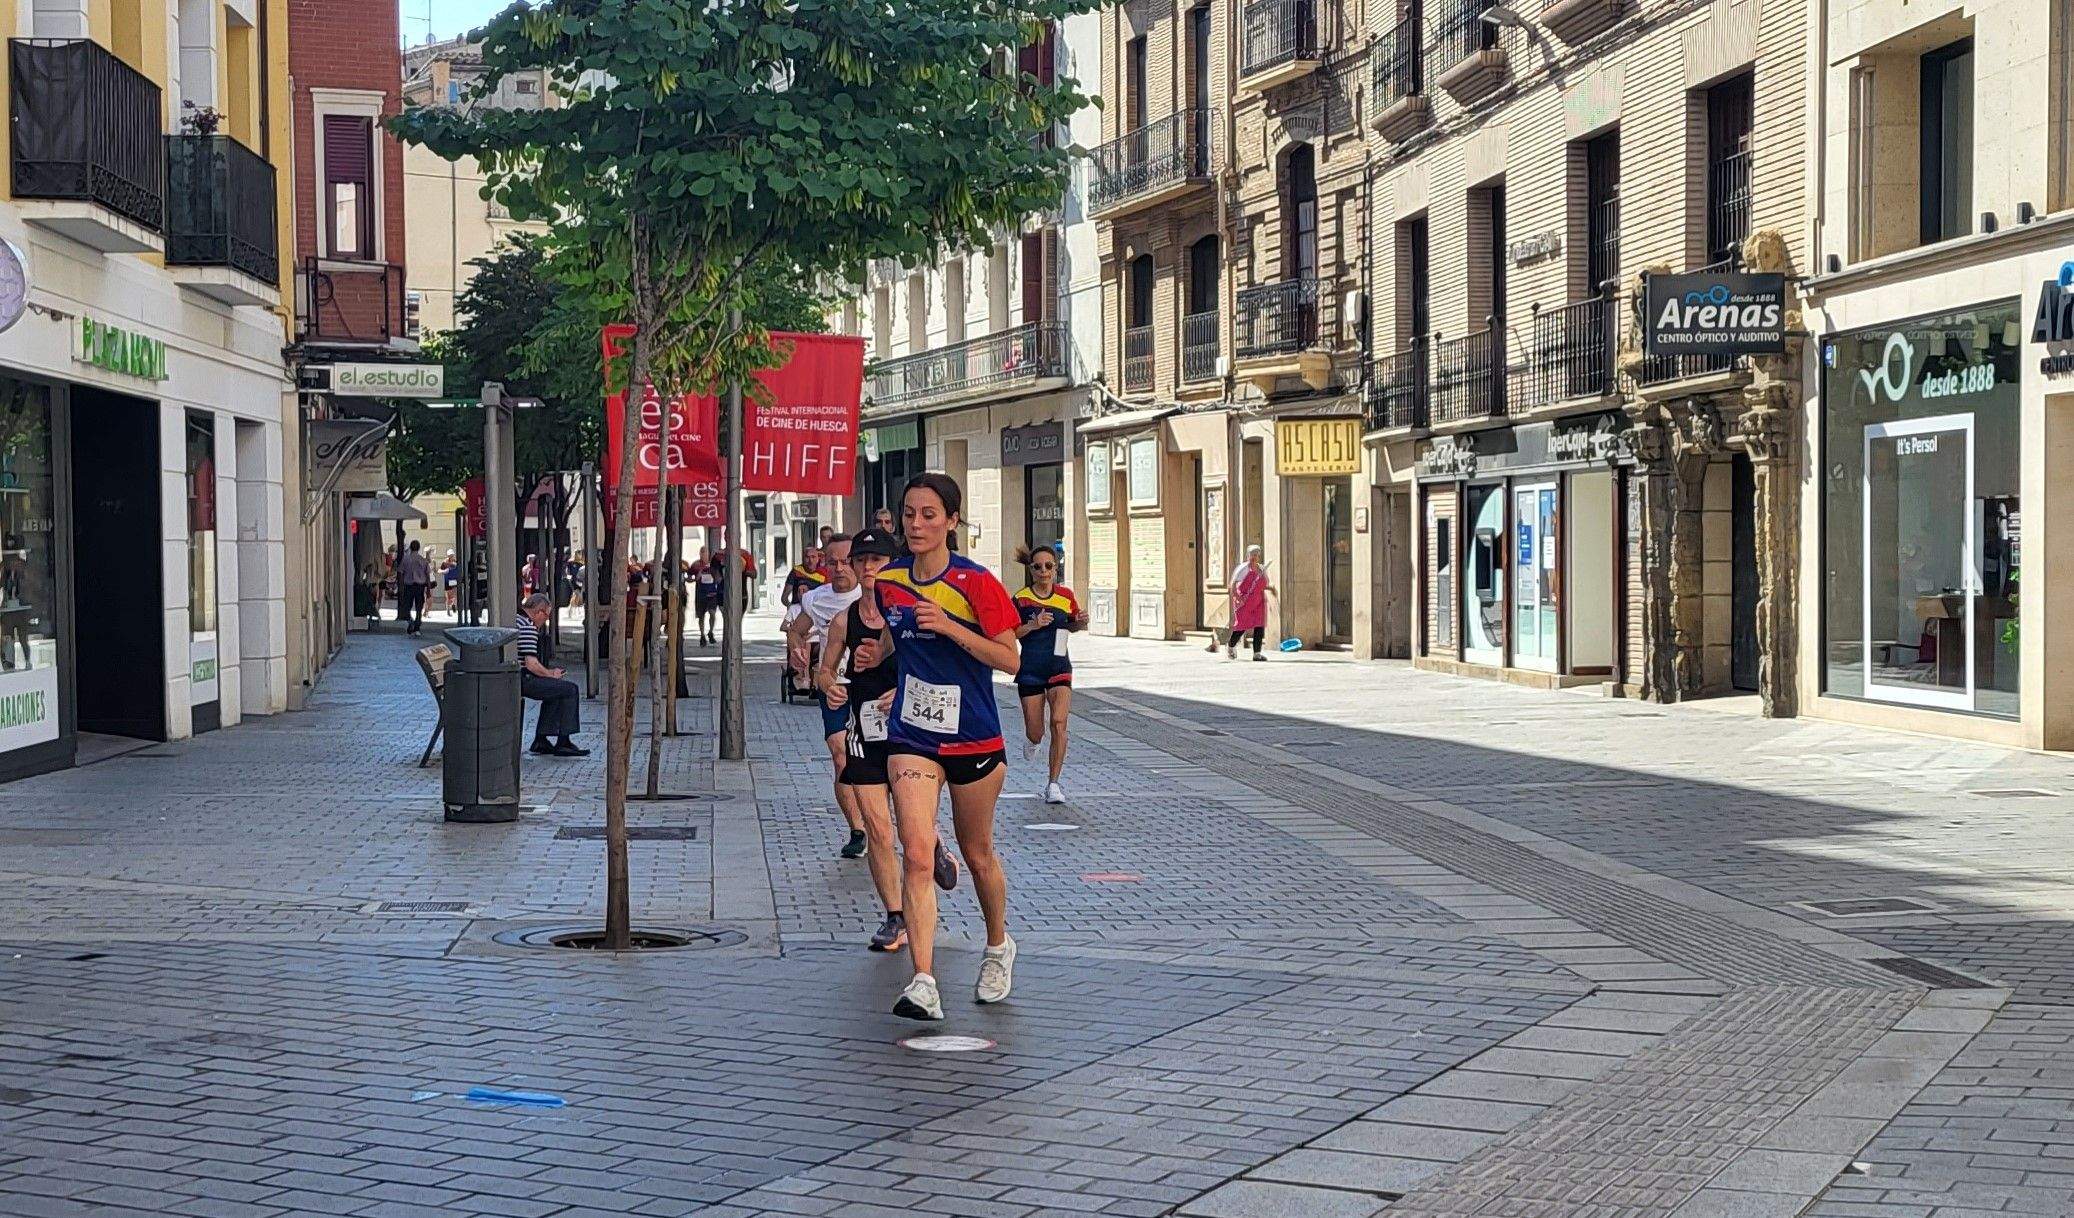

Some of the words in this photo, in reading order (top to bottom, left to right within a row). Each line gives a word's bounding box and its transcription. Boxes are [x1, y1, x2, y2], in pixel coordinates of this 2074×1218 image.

[1731, 294, 1754, 303] desde
[1657, 298, 1780, 329] Arenas
[2031, 280, 2074, 343] Ar
[1657, 333, 1693, 343] CENTRO
[1695, 331, 1728, 343] ÓPTICO
[1730, 333, 1737, 342] Y
[1738, 332, 1780, 342] AUDITIVO
[1922, 369, 1957, 398] desde
[1960, 363, 1995, 394] 1888
[757, 406, 789, 415] FESTIVAL
[791, 406, 848, 415] INTERNACIONAL
[757, 417, 769, 428] DE
[772, 418, 794, 429] CINE
[795, 419, 809, 430] DE
[810, 420, 848, 432] HUESCA
[1283, 423, 1355, 463] ASCASO
[1897, 437, 1911, 455] It's
[1912, 435, 1938, 454] Persol
[753, 441, 848, 480] HIFF
[693, 482, 719, 498] es
[694, 503, 719, 519] ca
[912, 702, 946, 723] 544
